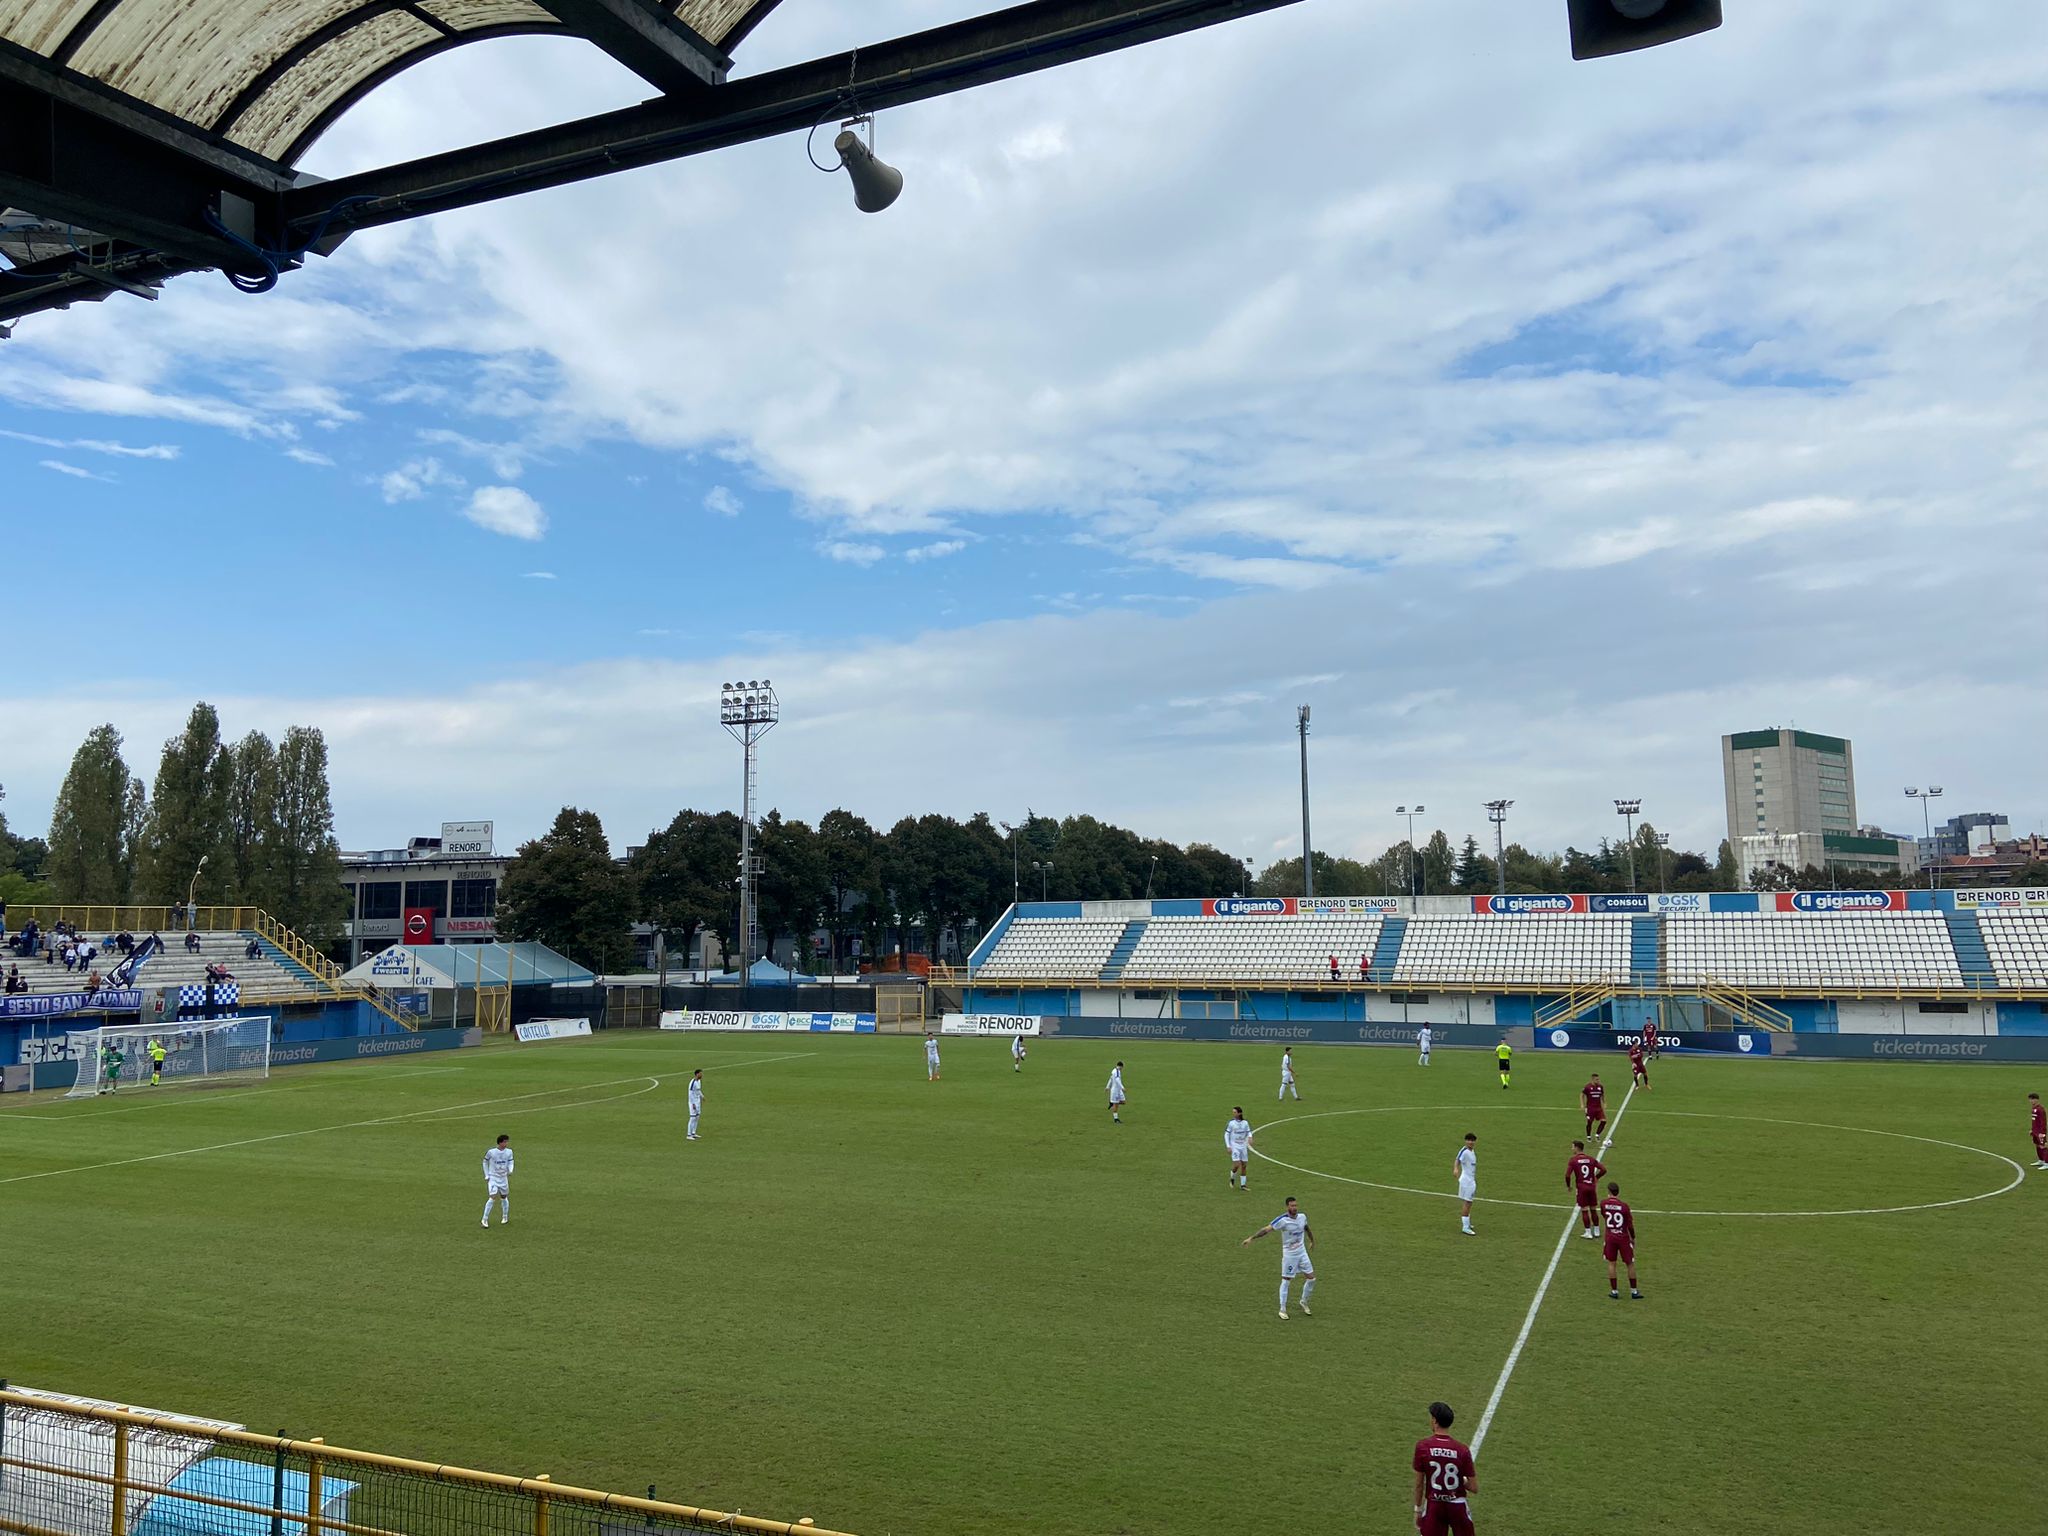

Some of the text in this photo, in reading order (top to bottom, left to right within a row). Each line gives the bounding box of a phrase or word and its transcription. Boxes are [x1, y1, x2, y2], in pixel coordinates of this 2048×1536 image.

[449, 843, 481, 852] RENORD
[457, 870, 491, 879] RENORD
[1671, 895, 1699, 905] GSK
[1801, 895, 1883, 909] il gigante
[1968, 892, 2020, 901] RENORD
[1220, 901, 1280, 913] il gigante
[1358, 899, 1397, 907] RENORD
[1496, 898, 1566, 910] il gigante
[447, 921, 495, 931] NISSAN
[8, 998, 49, 1014] SESTO
[53, 995, 82, 1011] SAN
[693, 1013, 739, 1025] RENORD
[760, 1014, 780, 1024] GSK
[979, 1016, 1033, 1030] RENORD
[1109, 1021, 1187, 1035] ticketmaster
[1230, 1023, 1313, 1038] ticketmaster
[1358, 1025, 1447, 1041] ticketmaer
[357, 1037, 426, 1054] ticketmaster
[1617, 1035, 1641, 1046] PRO
[1873, 1039, 1988, 1055] ticketmaster
[1581, 1164, 1590, 1178] 9
[1605, 1211, 1624, 1228] 29
[1430, 1448, 1458, 1459] VERZENI
[1429, 1461, 1459, 1490] 28
